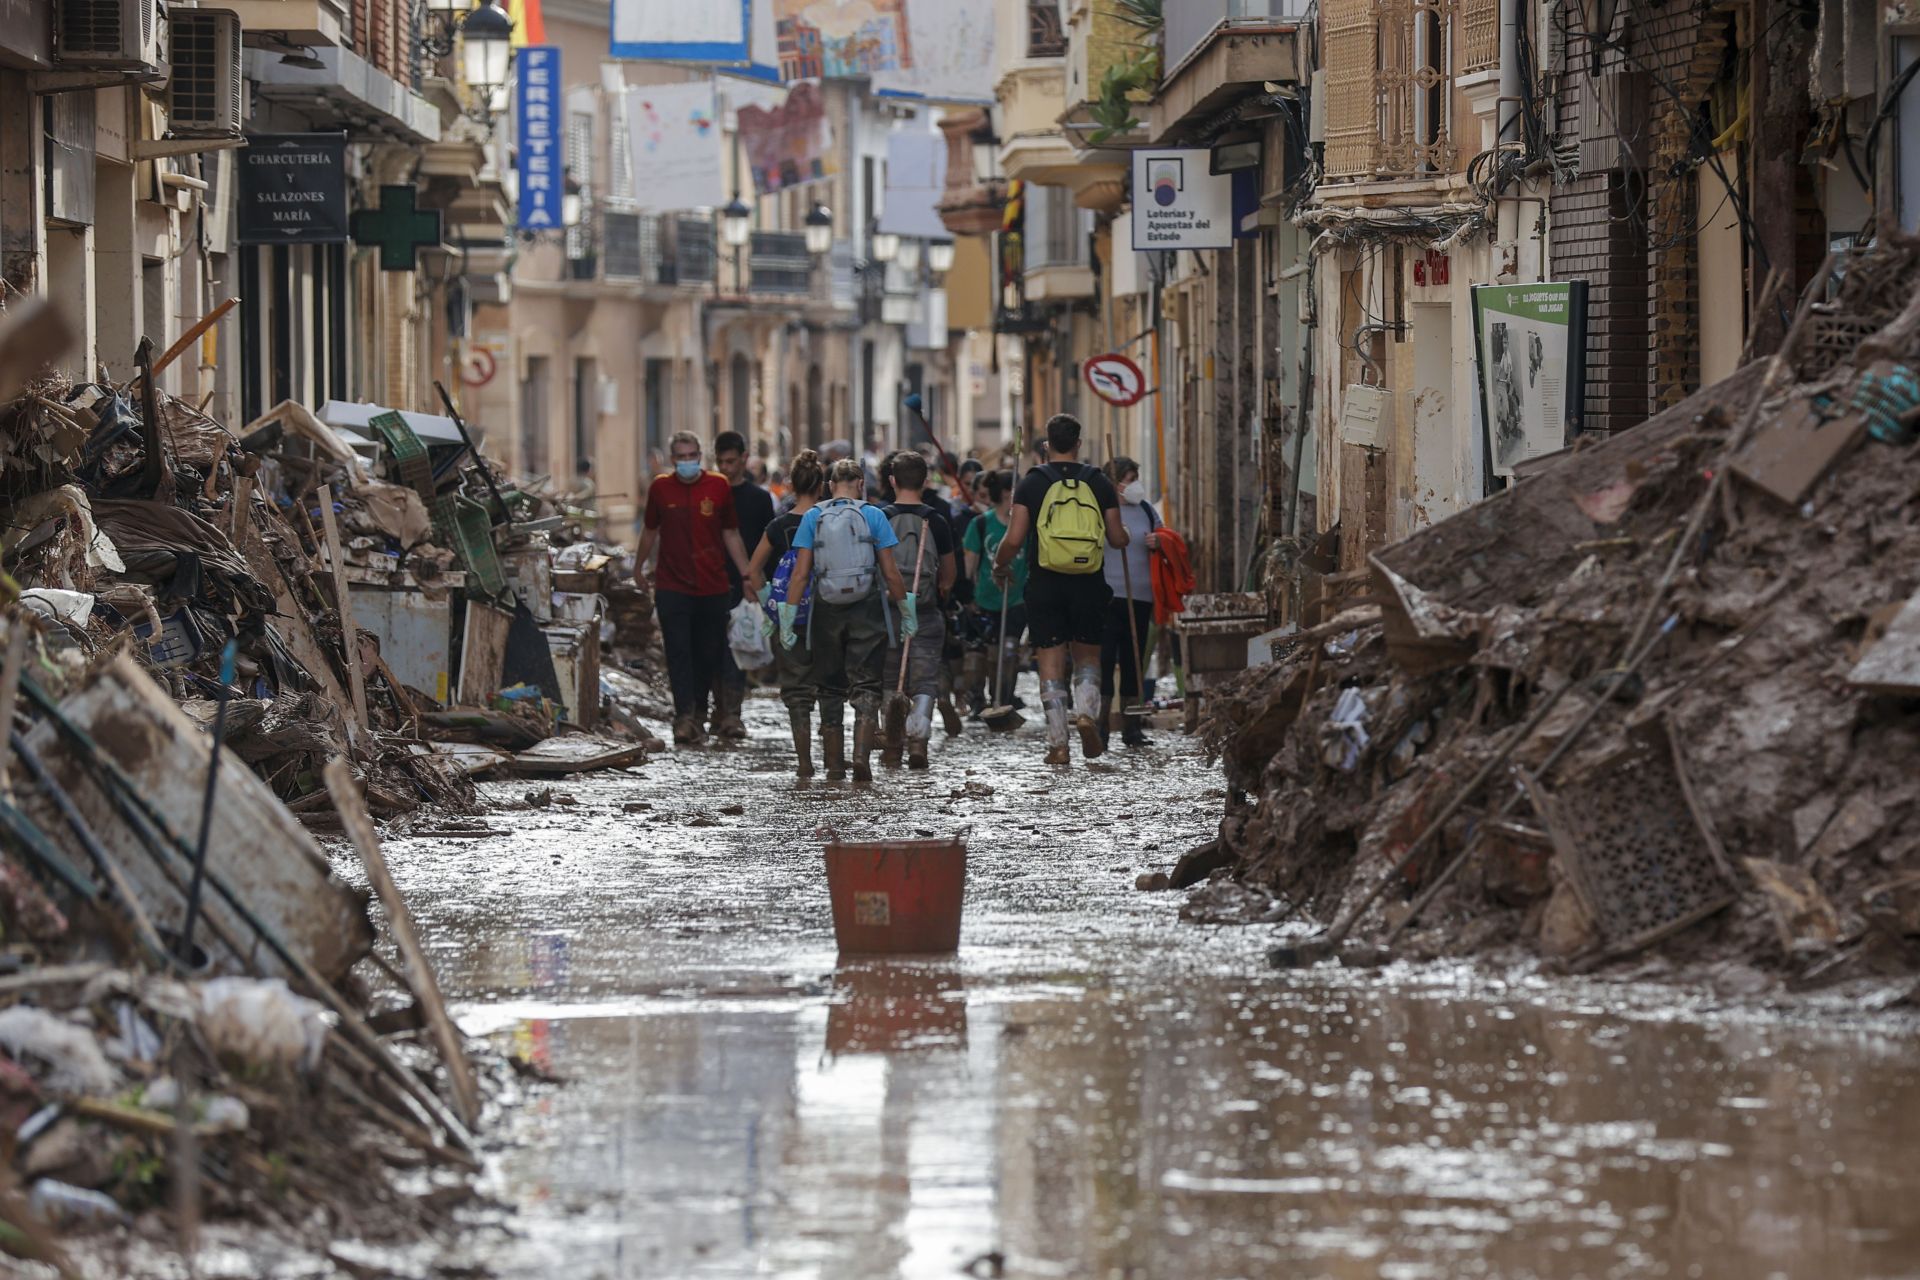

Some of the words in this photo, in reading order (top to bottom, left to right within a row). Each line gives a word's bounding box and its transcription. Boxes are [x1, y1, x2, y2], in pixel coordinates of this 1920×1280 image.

[526, 50, 552, 225] FERRETERIA
[248, 152, 331, 164] CHARCUTERÍA
[286, 172, 295, 183] Y
[257, 191, 325, 202] SALAZONES
[272, 209, 311, 221] MARÍA
[1146, 209, 1186, 218] Loterías
[1189, 210, 1195, 219] y
[1148, 220, 1193, 231] Apuestas
[1195, 219, 1210, 229] del
[1147, 231, 1181, 241] Estado
